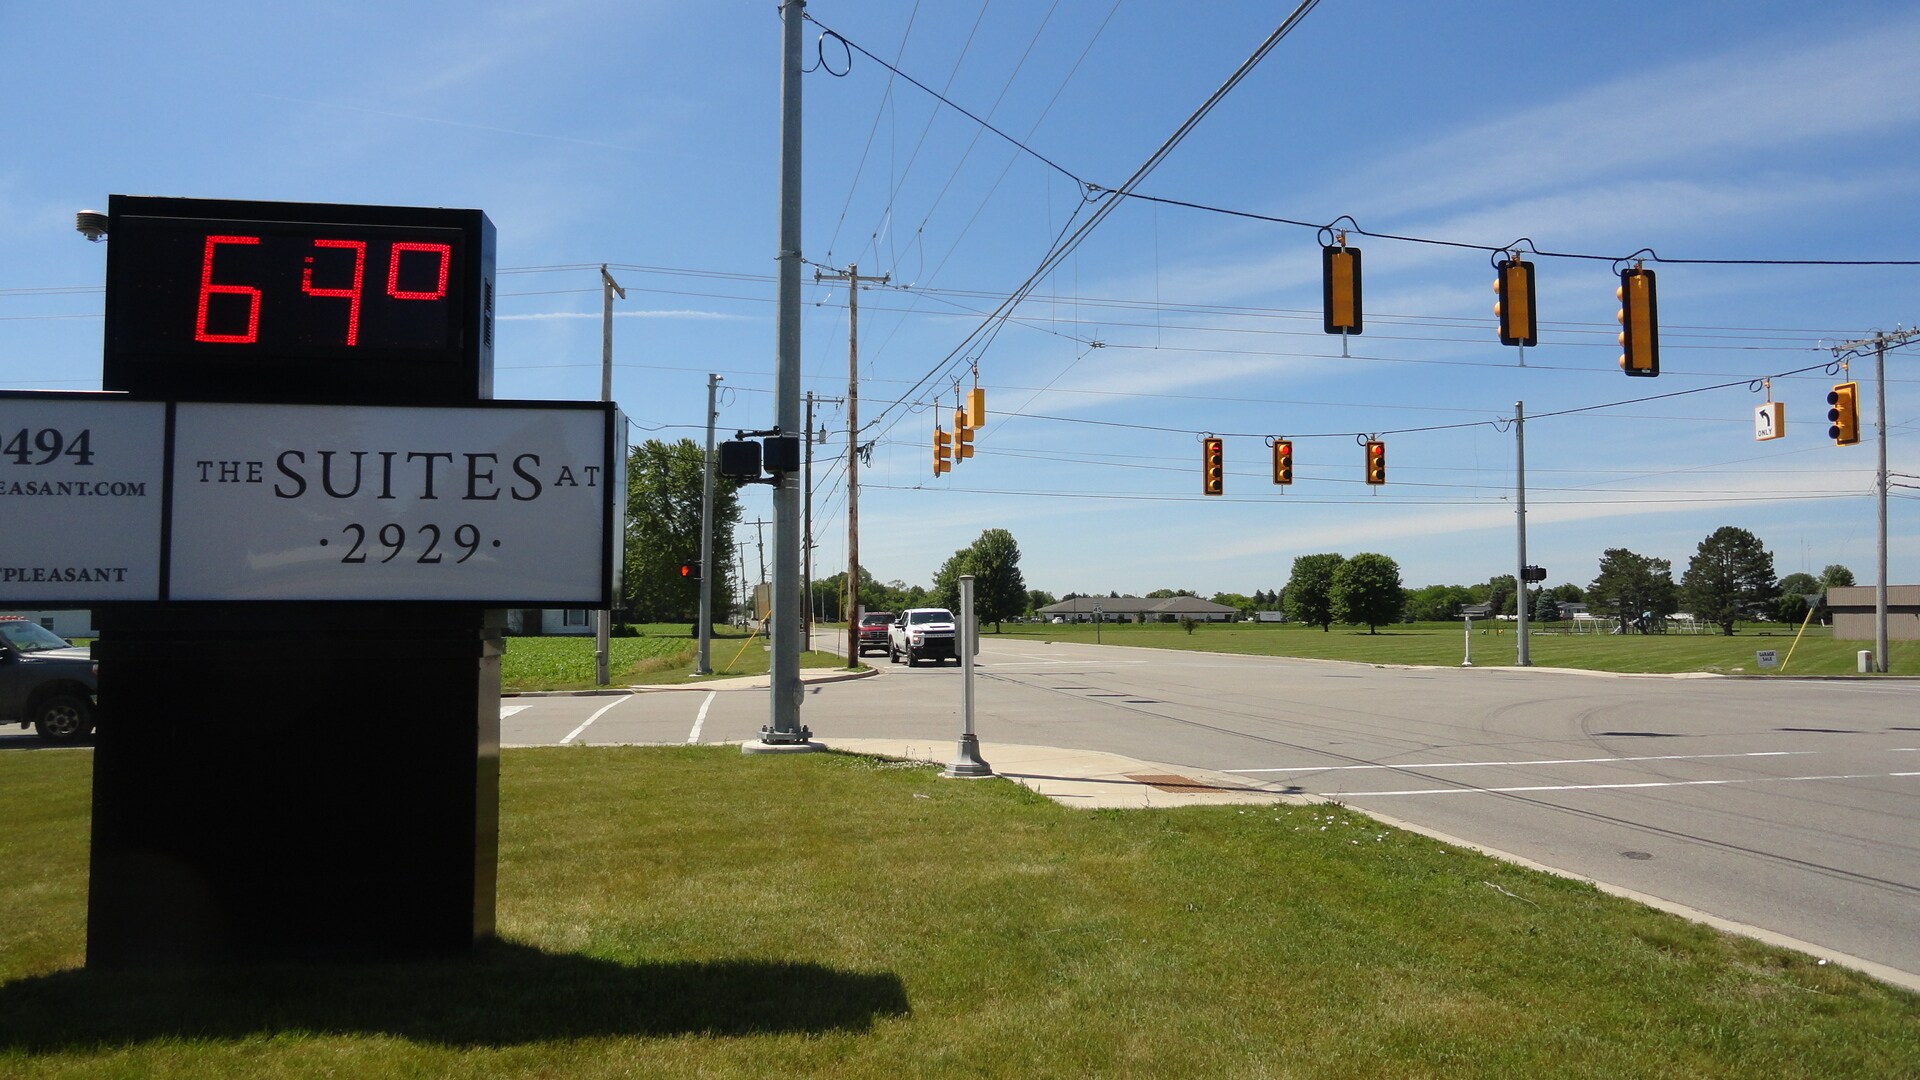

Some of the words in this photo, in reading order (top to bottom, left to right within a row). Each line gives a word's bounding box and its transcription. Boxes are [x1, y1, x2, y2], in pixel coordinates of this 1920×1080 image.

[1758, 428, 1772, 436] ONLY
[0, 428, 95, 466] 494
[197, 461, 263, 483] THE
[274, 450, 543, 501] SUITES
[554, 466, 600, 487] AT
[0, 567, 128, 583] PLEASANT
